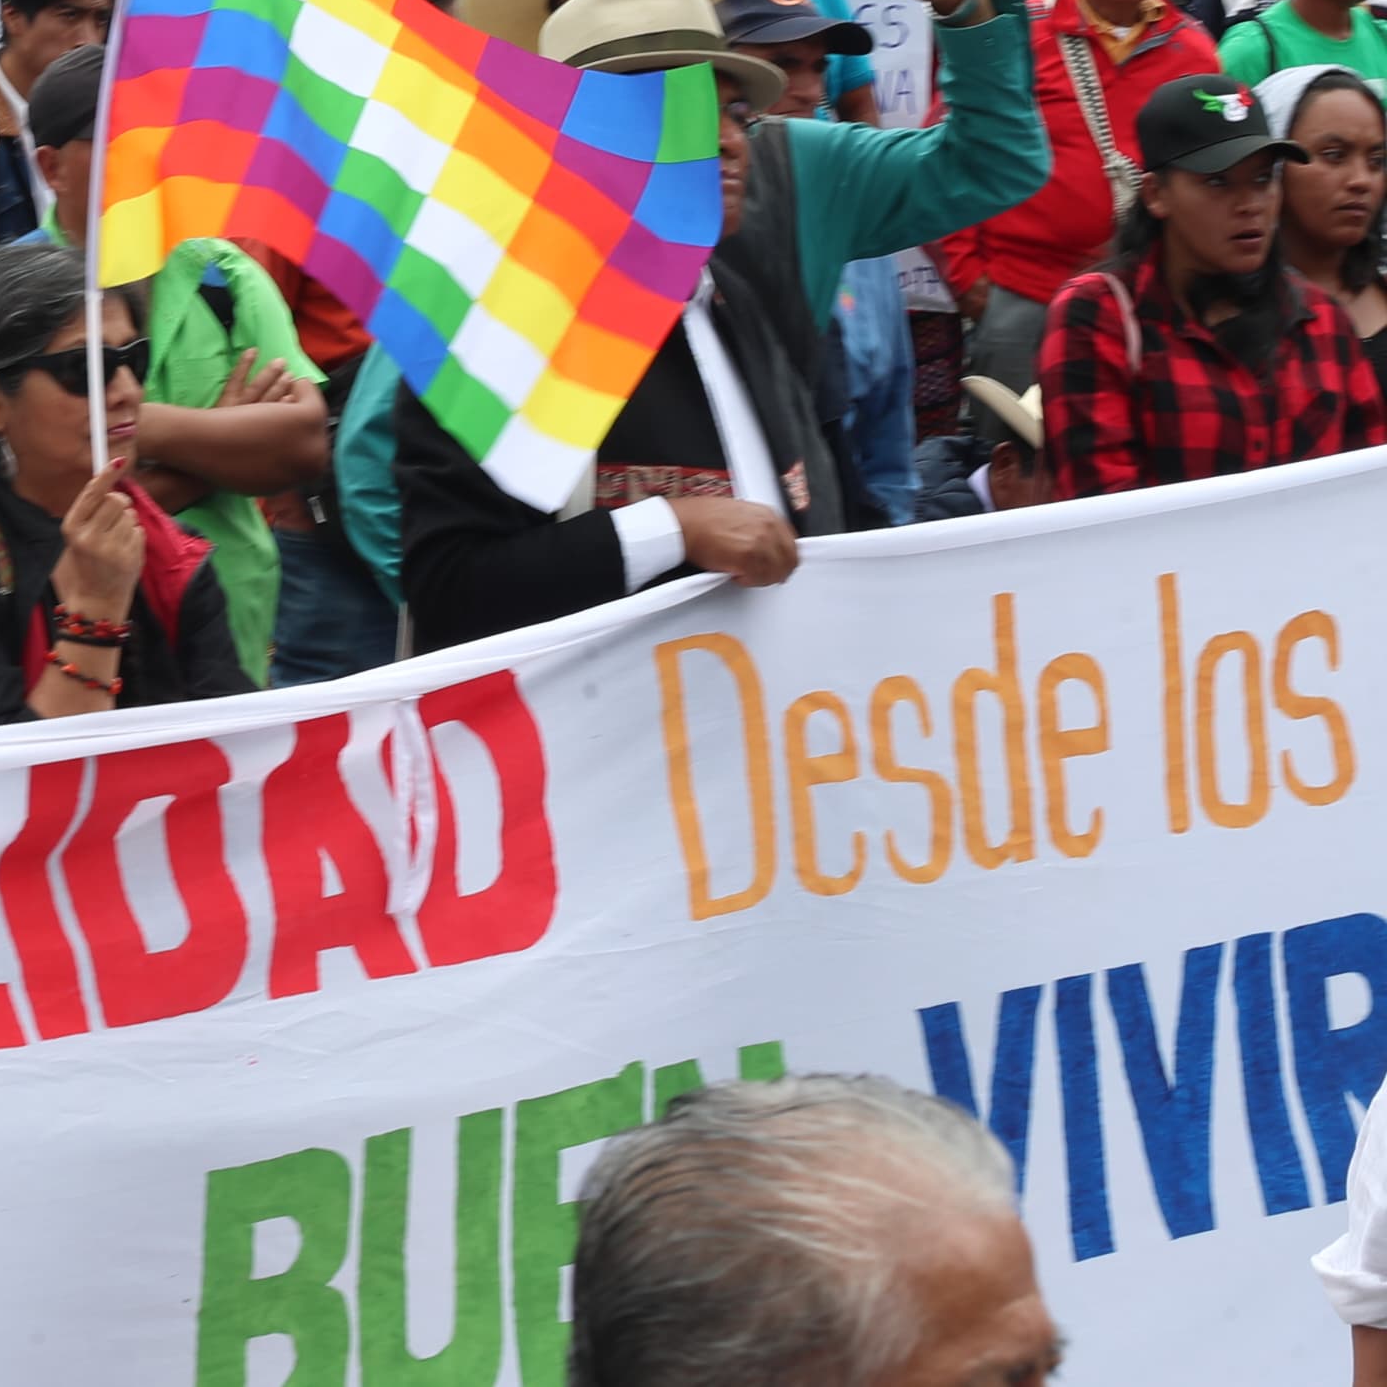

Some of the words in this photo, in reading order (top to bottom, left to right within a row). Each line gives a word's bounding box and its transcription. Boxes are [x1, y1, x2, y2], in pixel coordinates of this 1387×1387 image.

[655, 592, 1112, 922] Desde
[1157, 572, 1356, 834] los
[195, 1040, 785, 1387] BUE
